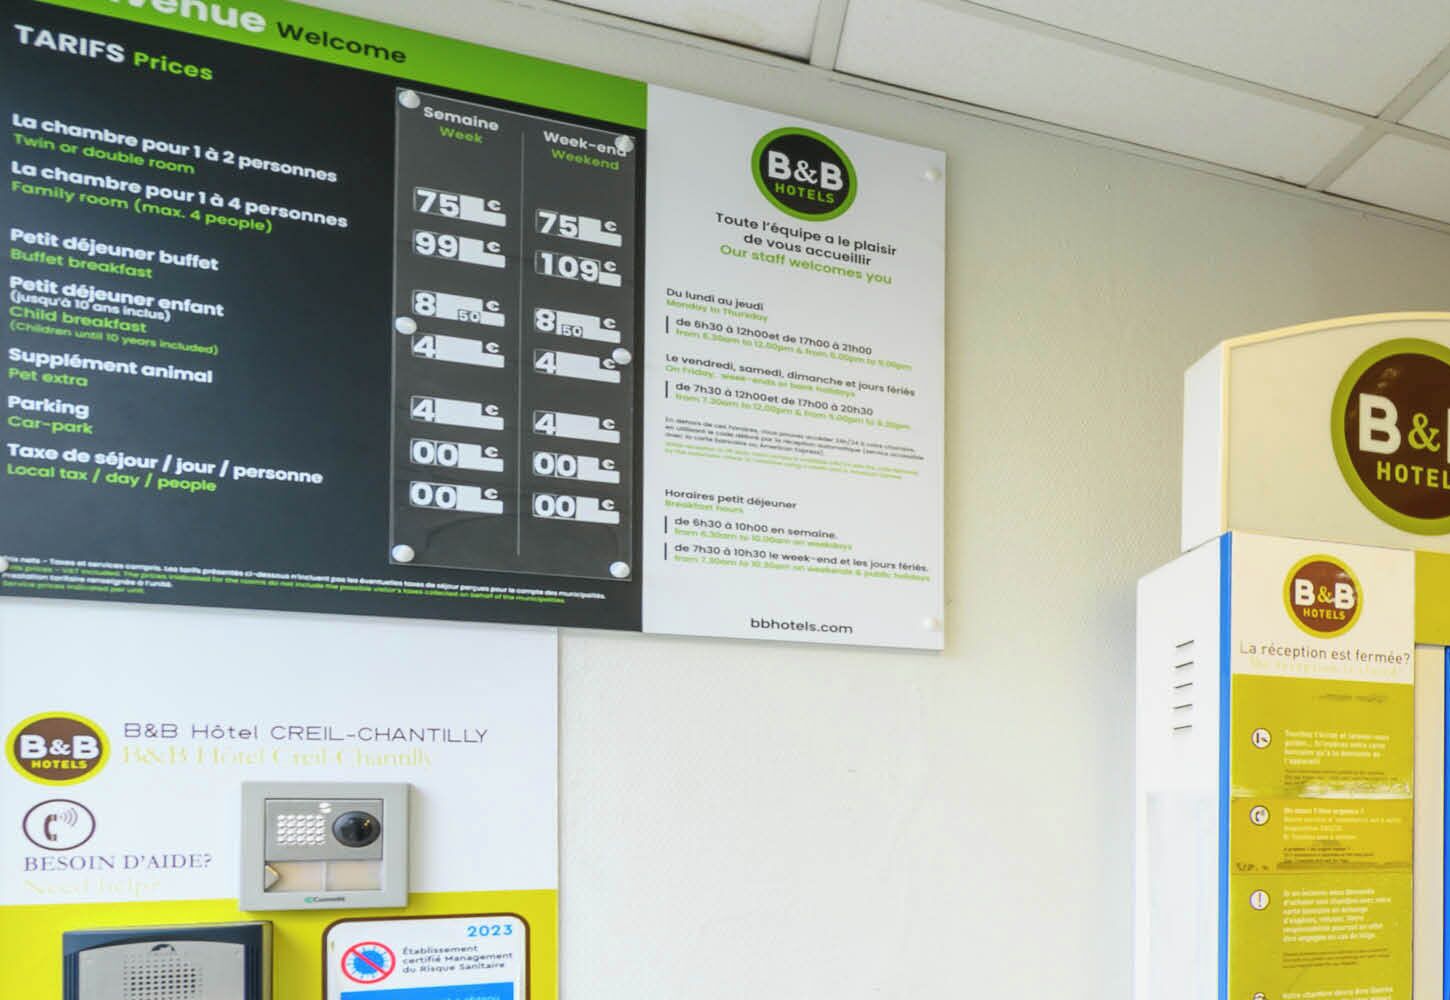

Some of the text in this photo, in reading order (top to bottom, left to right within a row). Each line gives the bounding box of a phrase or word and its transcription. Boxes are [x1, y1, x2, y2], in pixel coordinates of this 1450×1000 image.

[14, 24, 213, 80] TARIFS Prices
[276, 21, 407, 64] Welcome
[424, 106, 499, 131] Semaine
[12, 113, 337, 182] La chambre pour 1 à 2 personnes
[439, 127, 482, 144] Week
[13, 133, 194, 173] Twin or double room
[552, 149, 620, 171] Weekend
[768, 150, 843, 191] B&B
[11, 161, 347, 227] La chambre pour 1 à 4 personnes
[774, 182, 835, 204] HOTELS
[11, 181, 272, 234] Family room (max. 4 people)
[716, 212, 897, 255] Toute l'équipe a le plaisir
[10, 228, 218, 270] Petit déjeuner buffet
[744, 233, 870, 264] de vous accueillir
[10, 249, 152, 278] Buffet breakfast
[720, 245, 892, 284] Our staff welcomes you
[10, 276, 224, 316] Petit déjeuner enfant
[10, 290, 172, 322] (jusqu'à 10 ans inclus)
[8, 306, 146, 332] Child breakfast
[9, 348, 213, 382] Supplément animal
[9, 368, 88, 386] Pet extra
[8, 395, 89, 419] Parking
[8, 416, 93, 436] Car-park
[8, 443, 58, 460] Taxe
[62, 448, 90, 463] de
[94, 451, 158, 469] séjour
[175, 457, 215, 474] jour
[232, 465, 322, 482] personne
[664, 489, 714, 501] Horaires
[717, 494, 744, 505] petit
[746, 495, 796, 508] déjeuner
[1295, 578, 1355, 609] B&B
[750, 617, 853, 634] bbhotels.com
[1303, 607, 1346, 620] HOTELS
[1240, 640, 1411, 665] La réception est fermée?
[124, 723, 489, 743] B&B Hôtel CREIL-CHANTILLY
[20, 734, 100, 760] B&B
[31, 759, 88, 770] HOTELS
[24, 853, 213, 872] BESOIN D'AIDE?
[467, 924, 514, 938] 2023
[402, 952, 513, 965] certifié Management
[402, 962, 505, 974] du Risque Sanitaire
